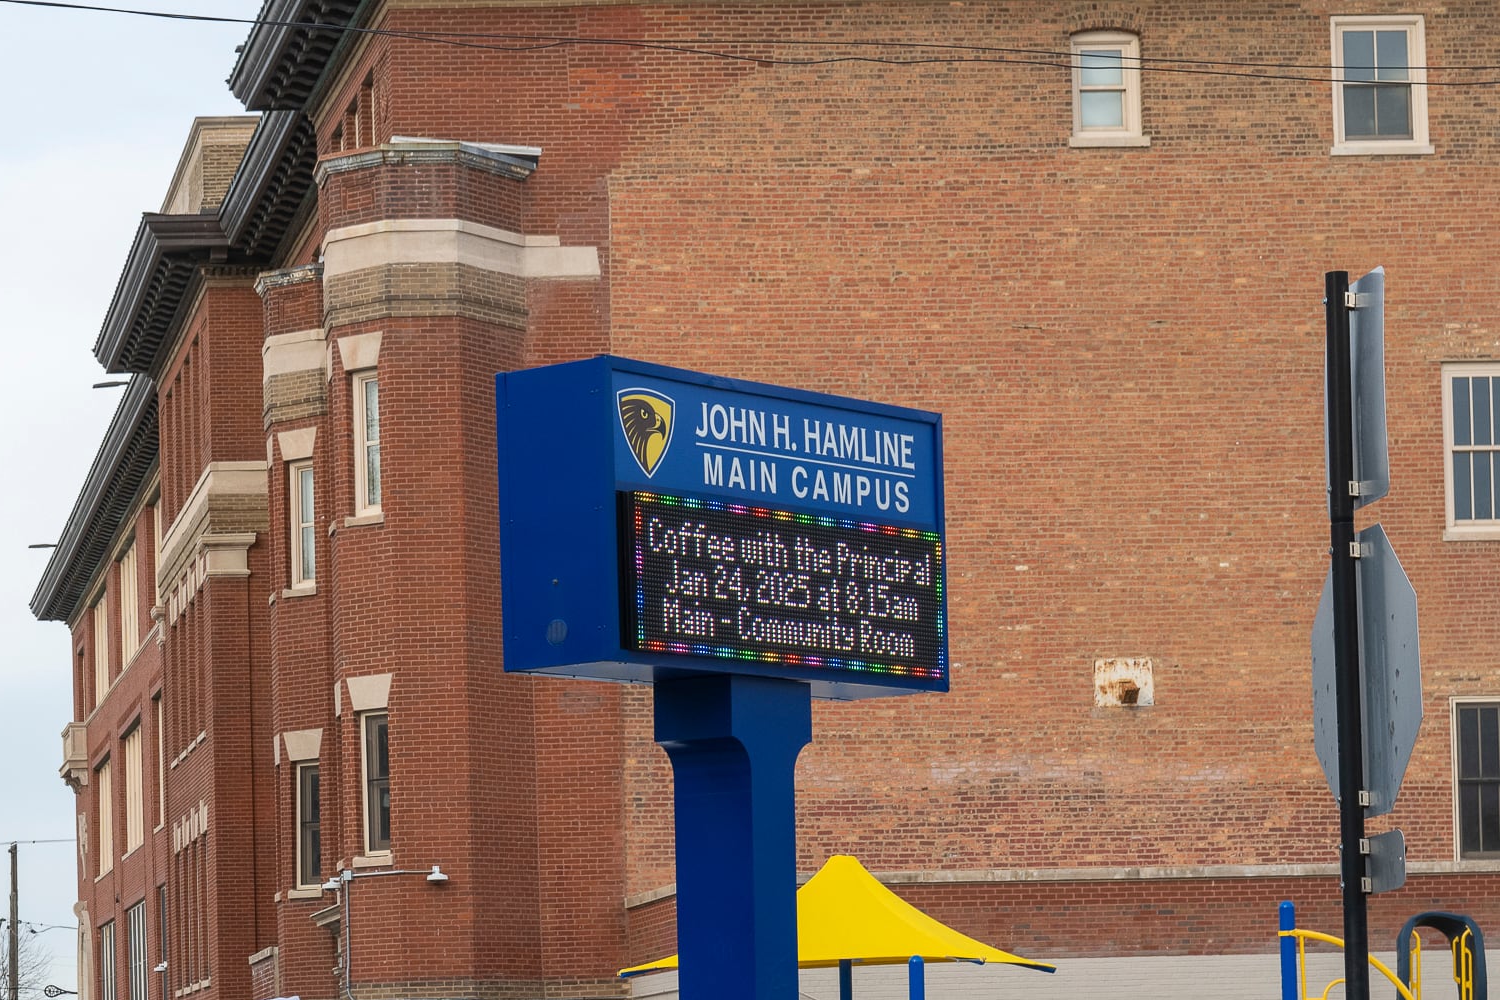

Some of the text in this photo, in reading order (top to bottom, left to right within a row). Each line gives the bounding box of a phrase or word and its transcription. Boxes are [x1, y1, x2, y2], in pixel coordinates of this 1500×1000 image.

[695, 402, 915, 471] JOHN H. HAMLINE
[703, 452, 910, 513] MAIN CAMPUS
[649, 517, 930, 586] Coffee with the Principal
[665, 559, 918, 621] Jan 24, 2025 at 8:15am
[663, 598, 714, 637] Main
[738, 606, 854, 650] Community
[860, 620, 914, 658] Room
